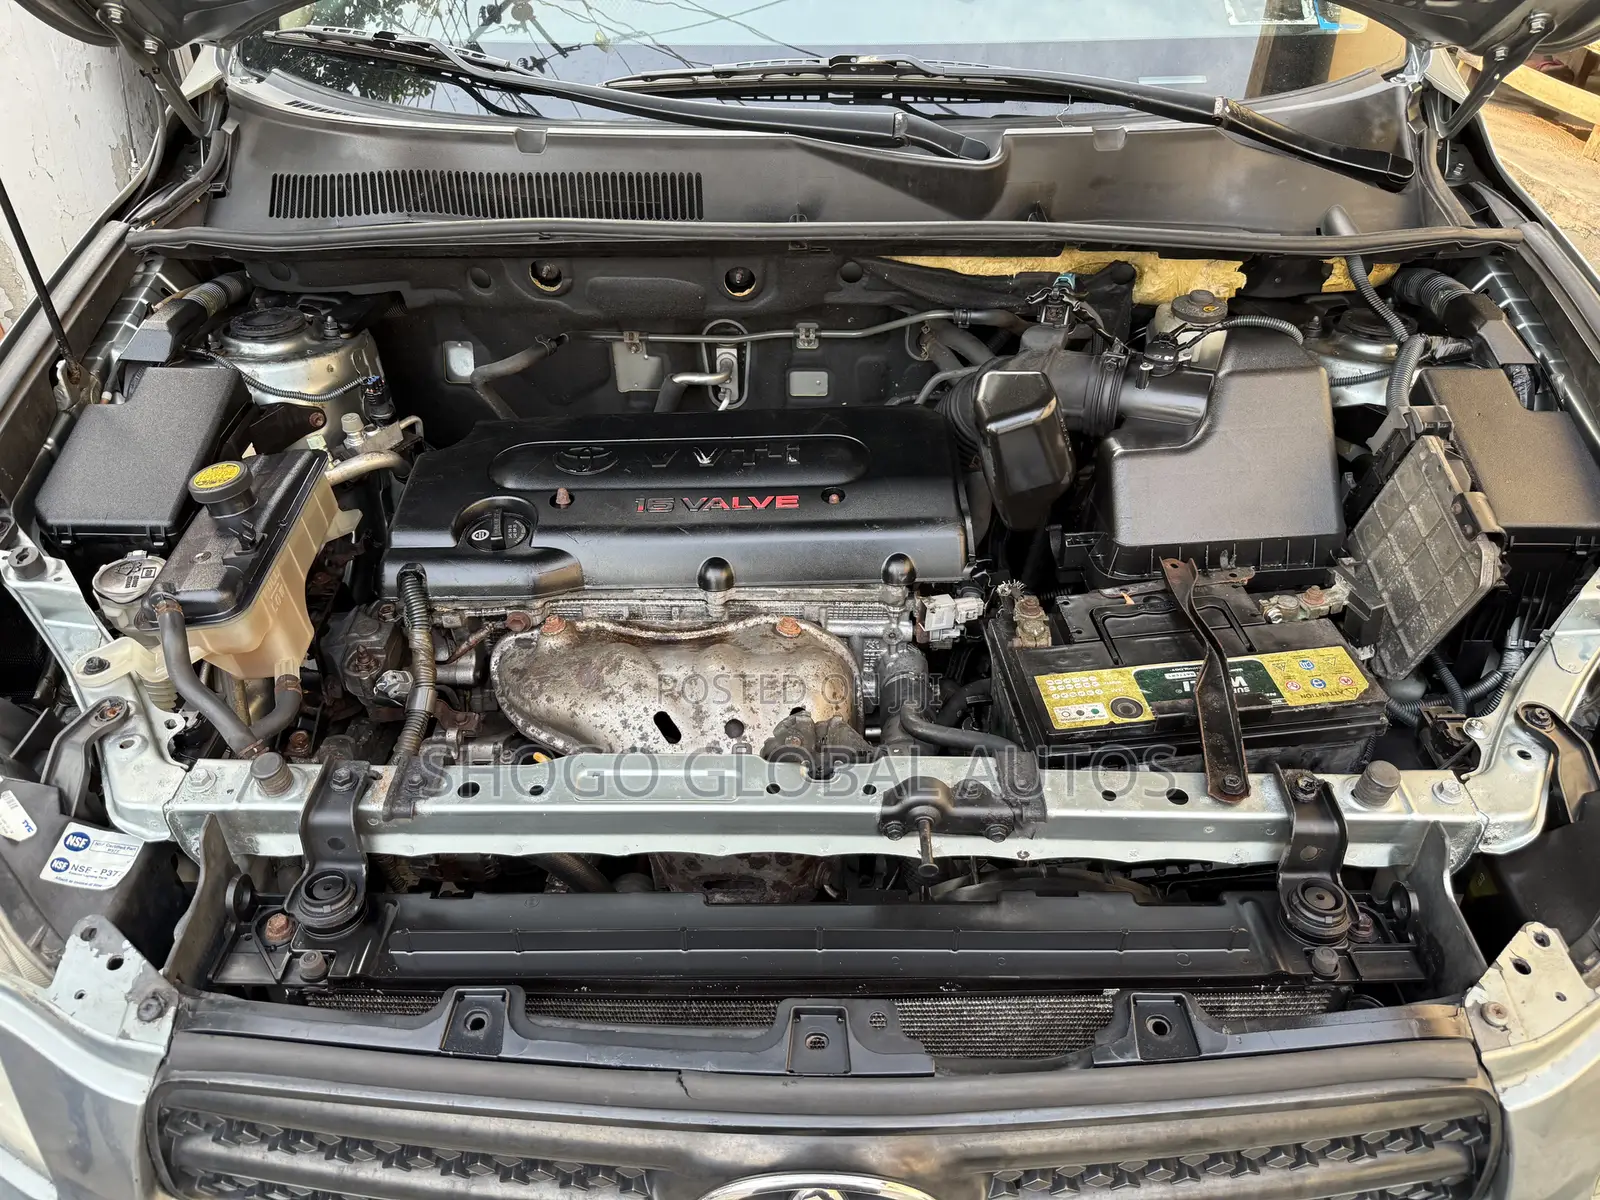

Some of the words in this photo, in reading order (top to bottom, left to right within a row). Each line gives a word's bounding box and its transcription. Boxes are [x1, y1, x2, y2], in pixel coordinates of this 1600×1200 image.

[681, 495, 800, 513] VALVE
[65, 834, 89, 849] NSF
[52, 859, 69, 871] NSF
[71, 863, 92, 874] NSF
